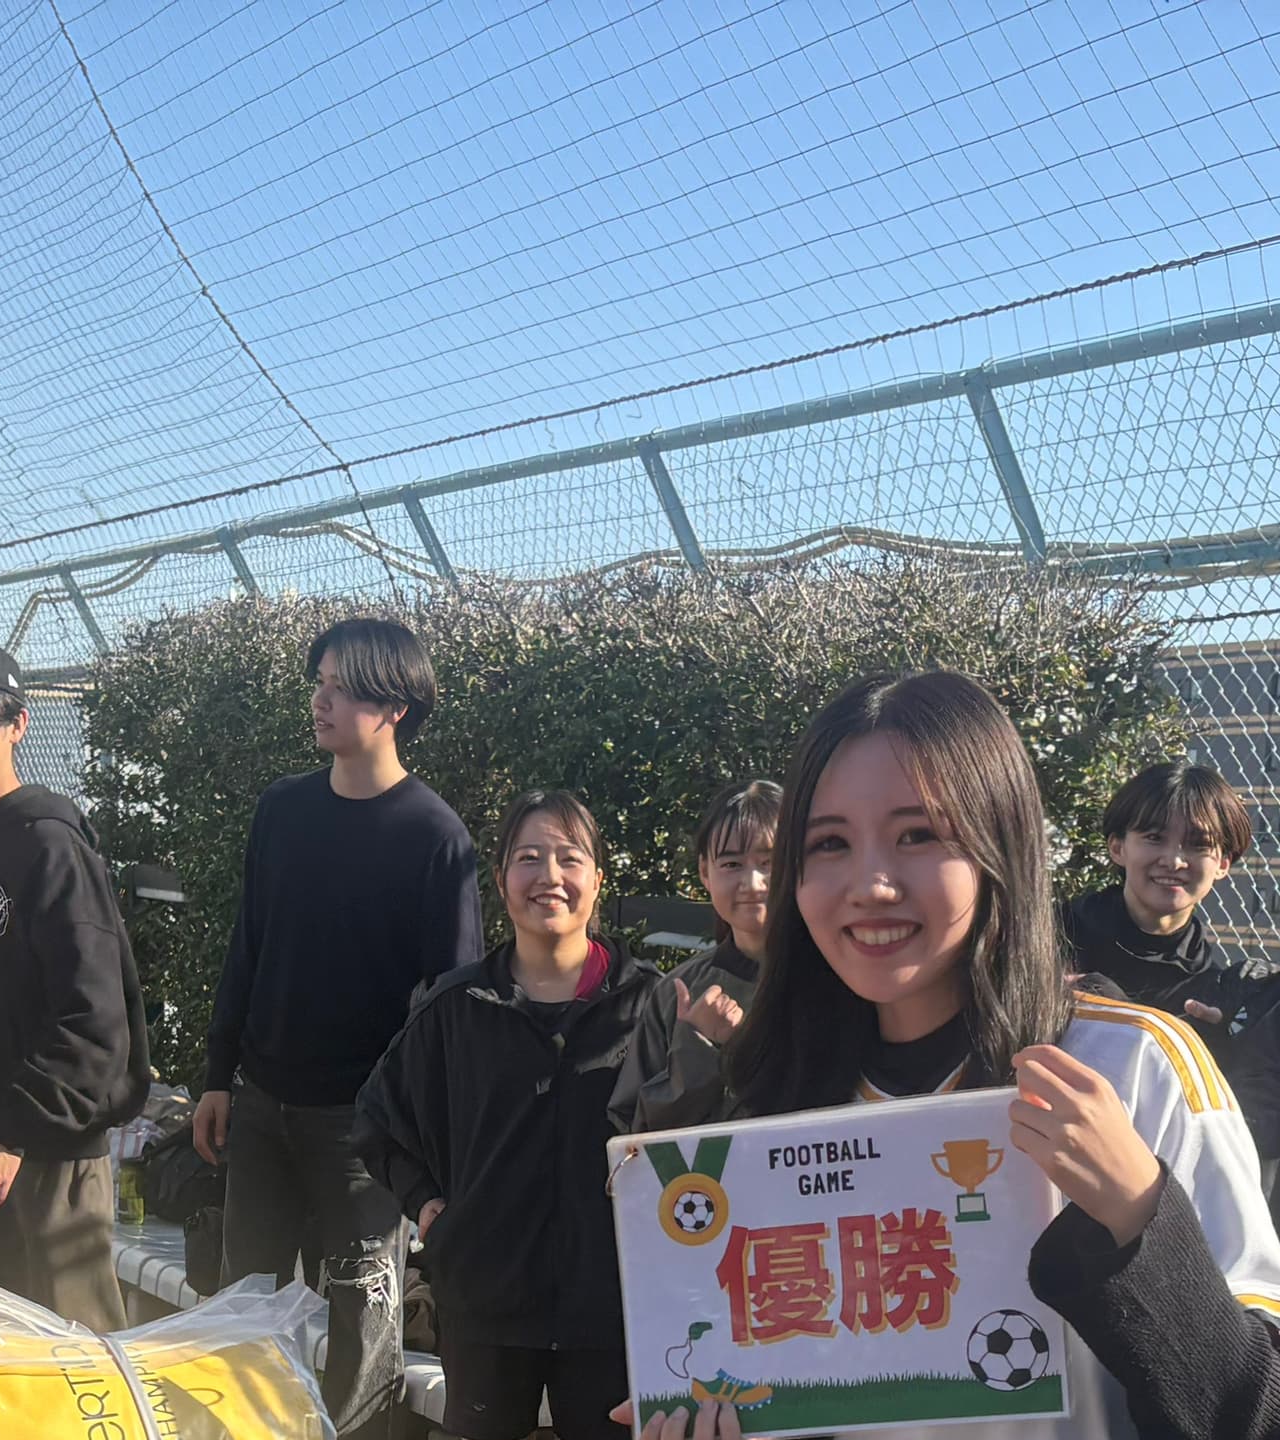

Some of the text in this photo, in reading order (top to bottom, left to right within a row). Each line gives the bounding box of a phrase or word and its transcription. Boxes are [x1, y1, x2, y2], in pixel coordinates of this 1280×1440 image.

[768, 1137, 881, 1170] FOOTBALL
[798, 1169, 855, 1196] GAME
[716, 1208, 960, 1347] 優勝
